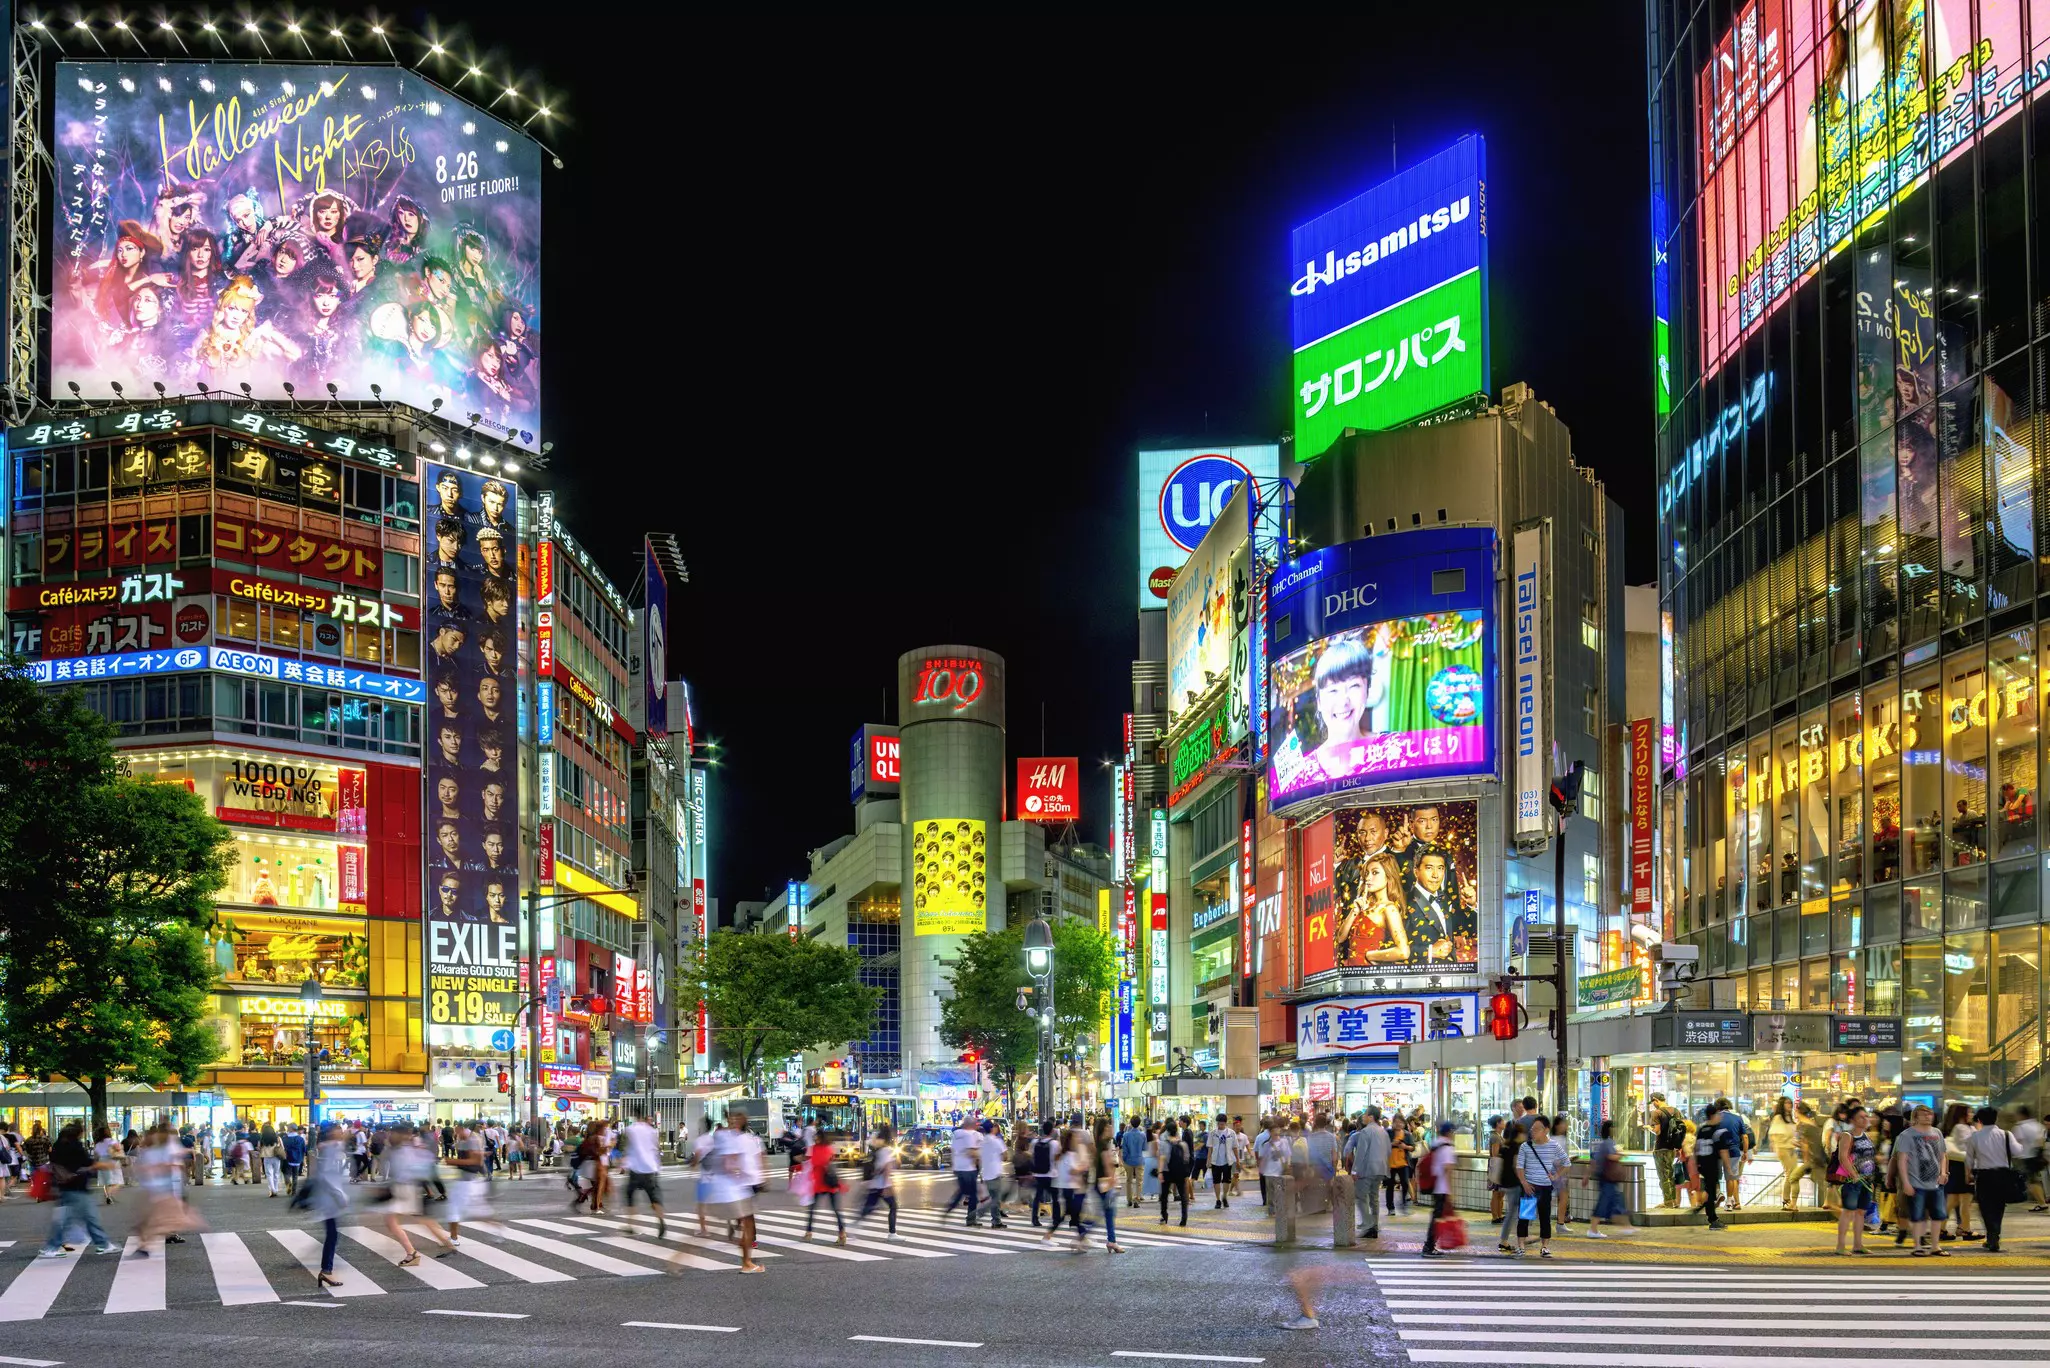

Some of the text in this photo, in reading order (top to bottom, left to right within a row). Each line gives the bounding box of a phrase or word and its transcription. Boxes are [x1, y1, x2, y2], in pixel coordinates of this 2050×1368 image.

[252, 105, 268, 118] 41st
[159, 72, 349, 190] Halloween
[274, 114, 370, 216] Night
[343, 124, 416, 194] AKB48
[435, 150, 479, 184] 8.26
[441, 176, 519, 204] ON THE FLOOR!!
[1290, 195, 1470, 296] Hisamitsu
[1300, 314, 1466, 419] サロンパス
[26, 421, 87, 444] 月の宴
[115, 409, 177, 432] 月の宴
[231, 412, 309, 445] 月の宴
[124, 446, 137, 456] 9F
[231, 440, 247, 450] 9F
[324, 436, 397, 467] 月の宴
[231, 446, 334, 496] 月の宴
[46, 525, 173, 564] プライス
[216, 521, 377, 577] コンタクト
[121, 572, 184, 604] ガスト
[1271, 560, 1322, 598] DHC Channel
[331, 593, 404, 629] ガスト
[1323, 583, 1377, 618] DHC
[13, 629, 42, 653] 7F
[86, 615, 165, 655] ガスト
[180, 621, 206, 633] ガスト
[56, 653, 171, 680] 英会話イーオン
[179, 652, 196, 666] 6F
[540, 638, 550, 669] ガスト
[925, 659, 983, 671] SHIBUYA
[1517, 562, 1538, 757] Taisei neon
[216, 650, 421, 697] AEON 英会話イーオン
[913, 668, 985, 712] 109
[595, 693, 614, 727] ガスト
[1949, 677, 2031, 735] COF
[231, 759, 322, 791] 1000%
[542, 758, 550, 811] 渋谷駅前ビル
[1030, 764, 1067, 790] H&M
[1341, 775, 1362, 788] DHC
[232, 781, 322, 805] WEDDING!
[1043, 794, 1064, 803] この先
[1043, 802, 1071, 812] 150m
[1518, 799, 1539, 810] 3719
[1519, 789, 1538, 800] (03)
[694, 775, 704, 845] BIC CAMERA
[1518, 809, 1539, 820] 2468
[1634, 724, 1651, 904] クスリのことなら 三千里
[540, 823, 553, 831] 5F
[1309, 853, 1329, 887] No.1
[345, 905, 359, 914] 4F
[1193, 899, 1230, 929] Euphoria
[1305, 886, 1332, 918] DMM
[1526, 894, 1538, 924] 大盛堂
[430, 921, 517, 966] EXILE
[1308, 913, 1329, 943] FX
[431, 964, 517, 978] 24karats GOLD SOUL
[431, 977, 518, 992] NEW SINGLE
[242, 998, 347, 1017] L'OCCITANE
[431, 990, 484, 1023] 8.19
[484, 1002, 500, 1013] ON
[1685, 1030, 1720, 1044] 渋谷駅
